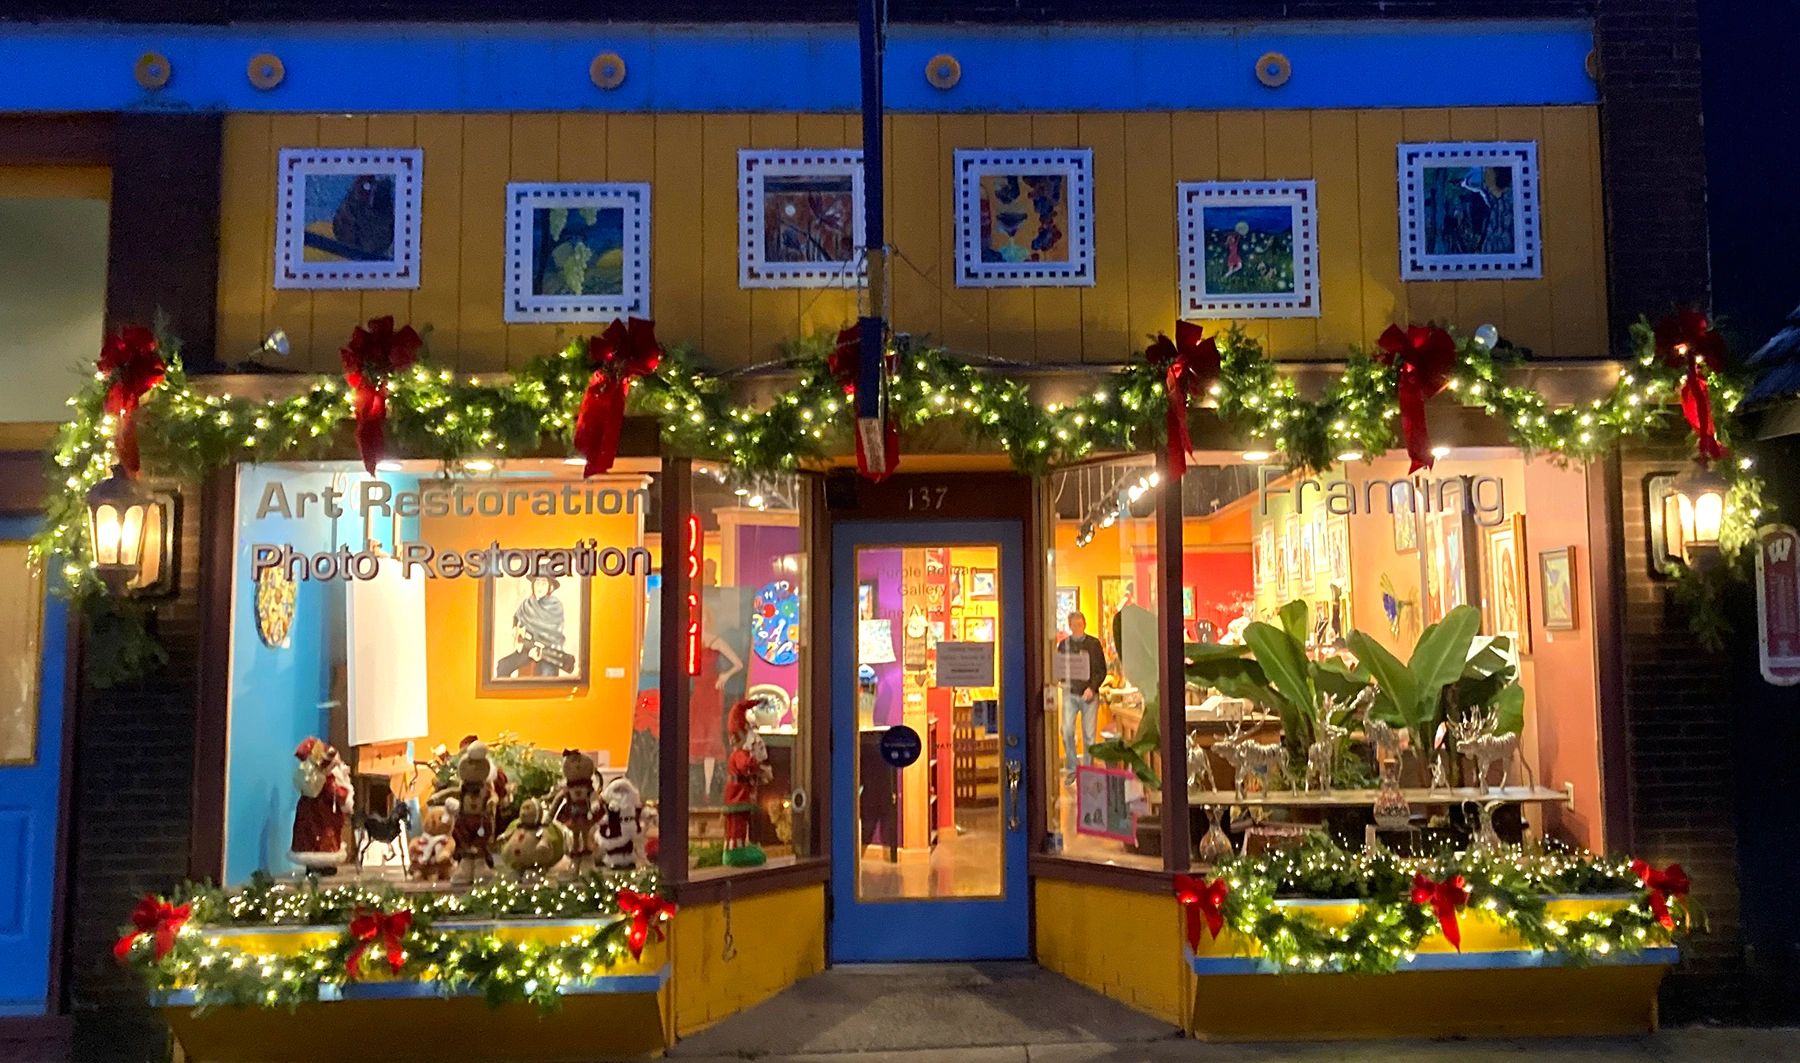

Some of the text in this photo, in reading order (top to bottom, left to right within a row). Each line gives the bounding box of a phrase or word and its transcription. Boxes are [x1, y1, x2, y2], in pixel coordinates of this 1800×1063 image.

[255, 479, 652, 519] Art Restoration
[907, 485, 948, 511] 137
[1258, 464, 1504, 527] Framing
[250, 538, 652, 581] Photo Restoration
[897, 584, 947, 598] Gallery
